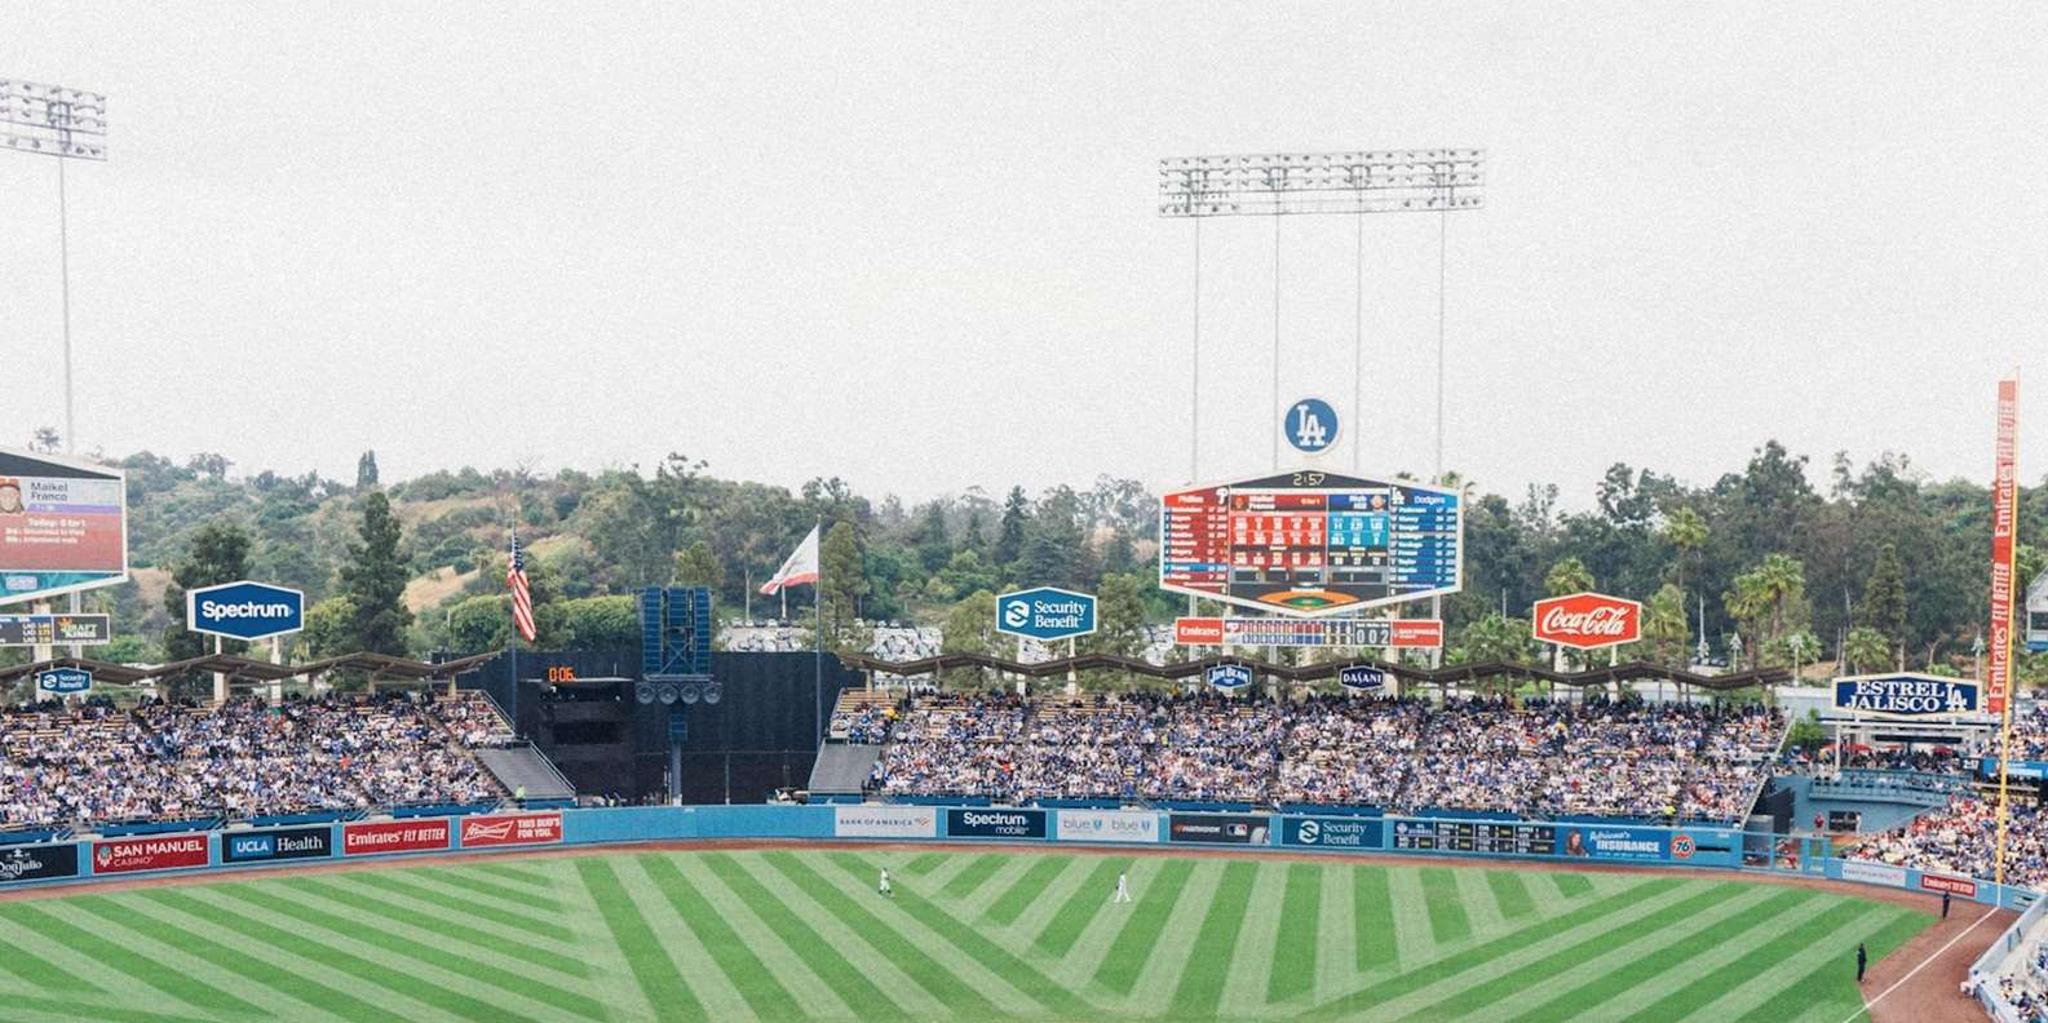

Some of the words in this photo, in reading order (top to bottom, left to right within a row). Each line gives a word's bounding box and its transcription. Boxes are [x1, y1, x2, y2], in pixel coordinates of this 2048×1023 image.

[1297, 404, 1327, 446] LA
[31, 482, 68, 491] Maikel
[1292, 473, 1325, 486] 2:57
[32, 492, 68, 501] Franco
[1414, 496, 1445, 505] Dodgers
[202, 601, 289, 622] Spectrum
[1035, 600, 1087, 616] Security
[1035, 616, 1080, 629] Benefit
[1542, 606, 1630, 635] Coca-Cola
[1180, 627, 1221, 637] Emirates
[1369, 629, 1377, 643] 0
[1381, 629, 1389, 643] 2
[1990, 626, 2007, 698] Emirates
[1343, 673, 1382, 688] DASANI
[1845, 696, 1941, 712] JALISCO
[517, 820, 536, 828] THIS
[963, 812, 1026, 827] Spectrum
[1063, 817, 1091, 830] blue
[1111, 817, 1139, 832] blue
[517, 829, 534, 838] FOR
[995, 826, 1026, 835] mobile
[1322, 821, 1367, 836] Security
[347, 831, 400, 847] Emirates
[403, 829, 417, 842] FLY
[418, 827, 445, 841] BETTER
[1323, 833, 1360, 846] Benefit
[113, 845, 144, 858] SAN
[146, 839, 204, 856] MANUEL
[236, 841, 269, 853] UCLA
[277, 836, 323, 852] Health
[1596, 841, 1660, 853] INSURANCE
[1676, 841, 1690, 852] 76
[114, 857, 152, 867] CASINO
